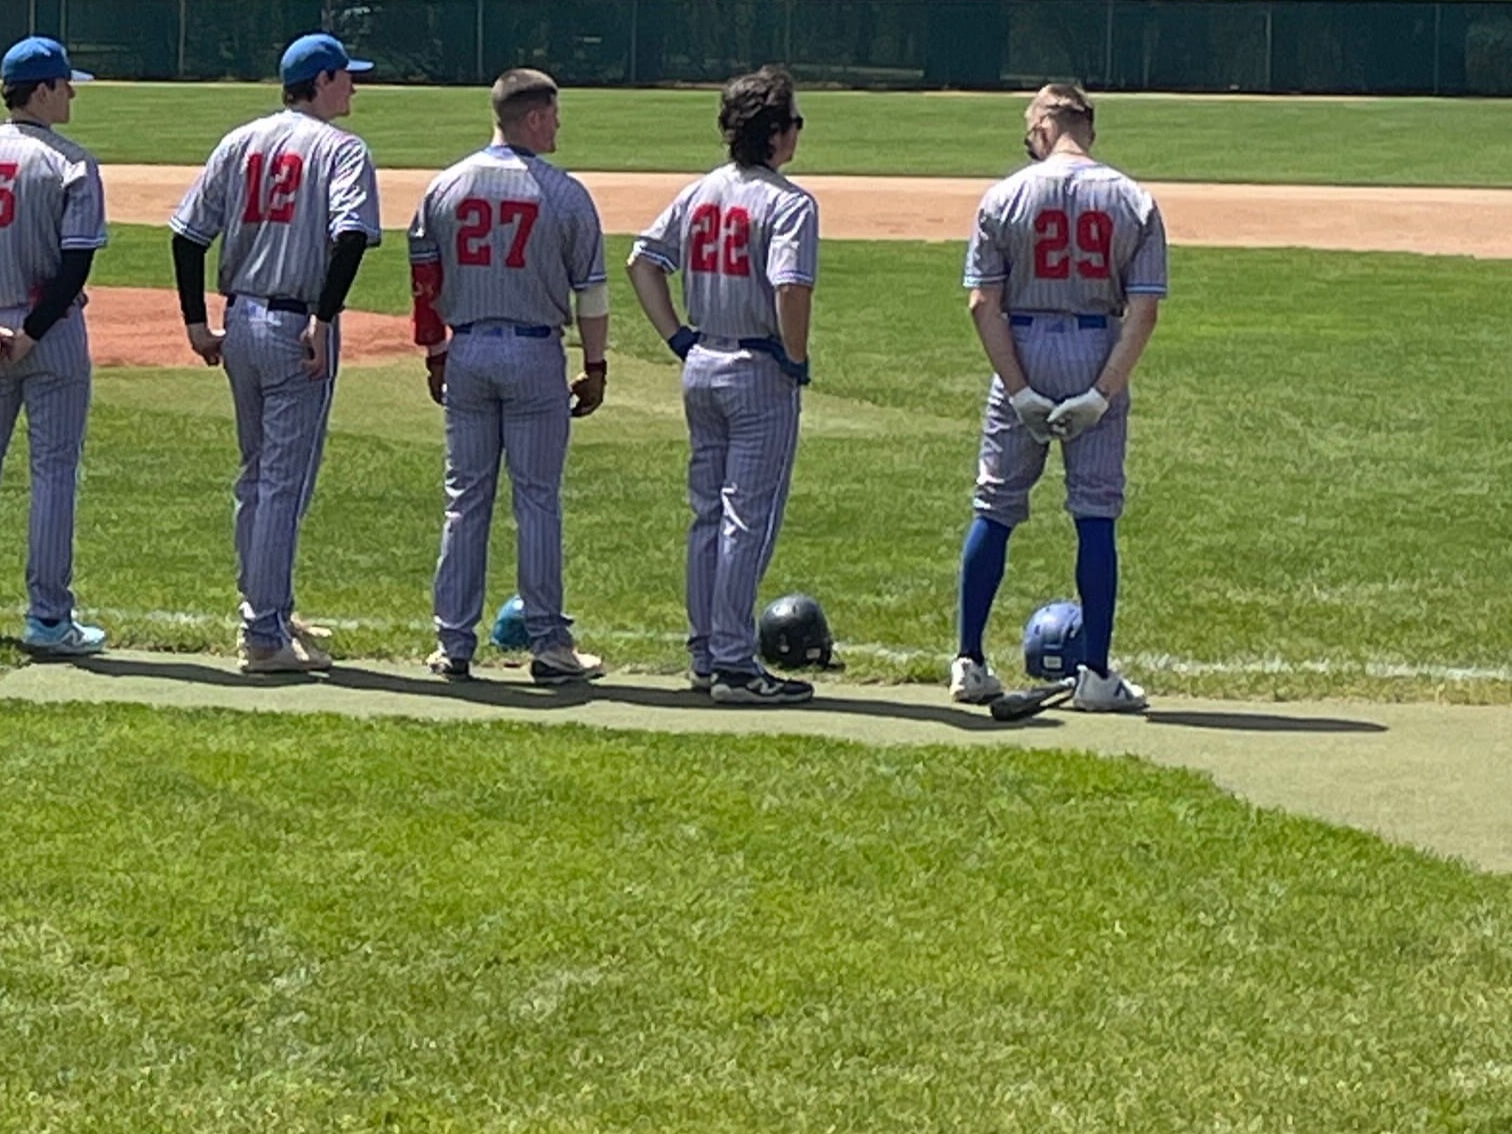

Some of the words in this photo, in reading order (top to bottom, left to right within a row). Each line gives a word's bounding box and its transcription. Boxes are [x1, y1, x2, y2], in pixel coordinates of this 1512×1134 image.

[242, 152, 303, 224] 12
[456, 199, 539, 268] 27
[690, 202, 750, 277] 22
[1034, 209, 1114, 280] 29
